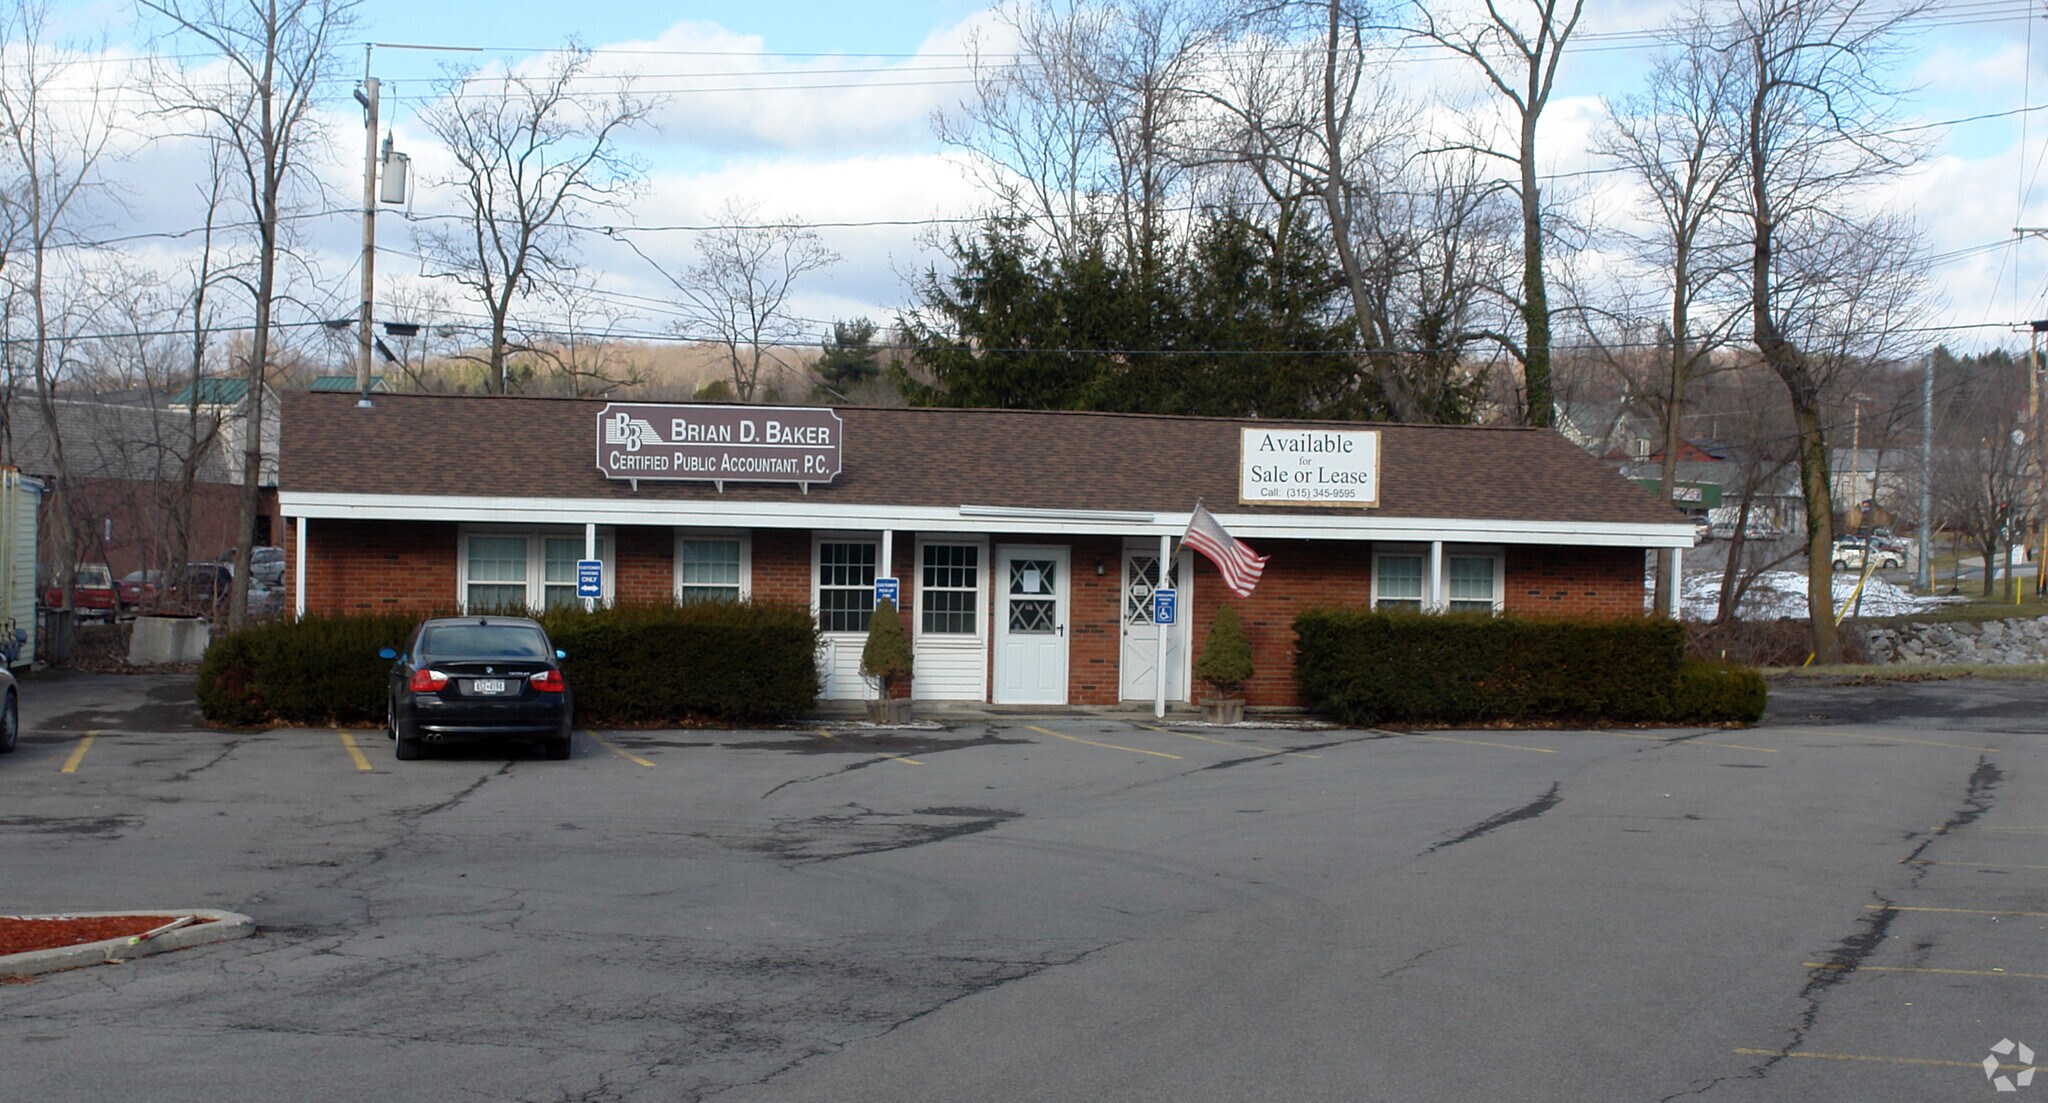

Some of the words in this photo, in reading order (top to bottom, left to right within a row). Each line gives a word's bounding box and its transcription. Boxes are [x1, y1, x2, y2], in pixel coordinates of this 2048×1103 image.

[671, 418, 731, 442] BRIAN
[740, 420, 760, 443] D.
[766, 421, 830, 444] BAKER
[1259, 433, 1353, 453] Available
[610, 451, 669, 470] CERTIFIED
[674, 452, 717, 472] PUBLIC
[720, 453, 799, 475] ACCOUNTANT,
[804, 455, 829, 474] P.C.
[1299, 456, 1312, 466] for
[1251, 465, 1289, 483] Sale
[1294, 471, 1313, 484] or
[1318, 467, 1368, 484] Lease
[1260, 487, 1281, 497] Call:
[1286, 488, 1311, 499] (315)
[1313, 488, 1356, 498] 345-9595
